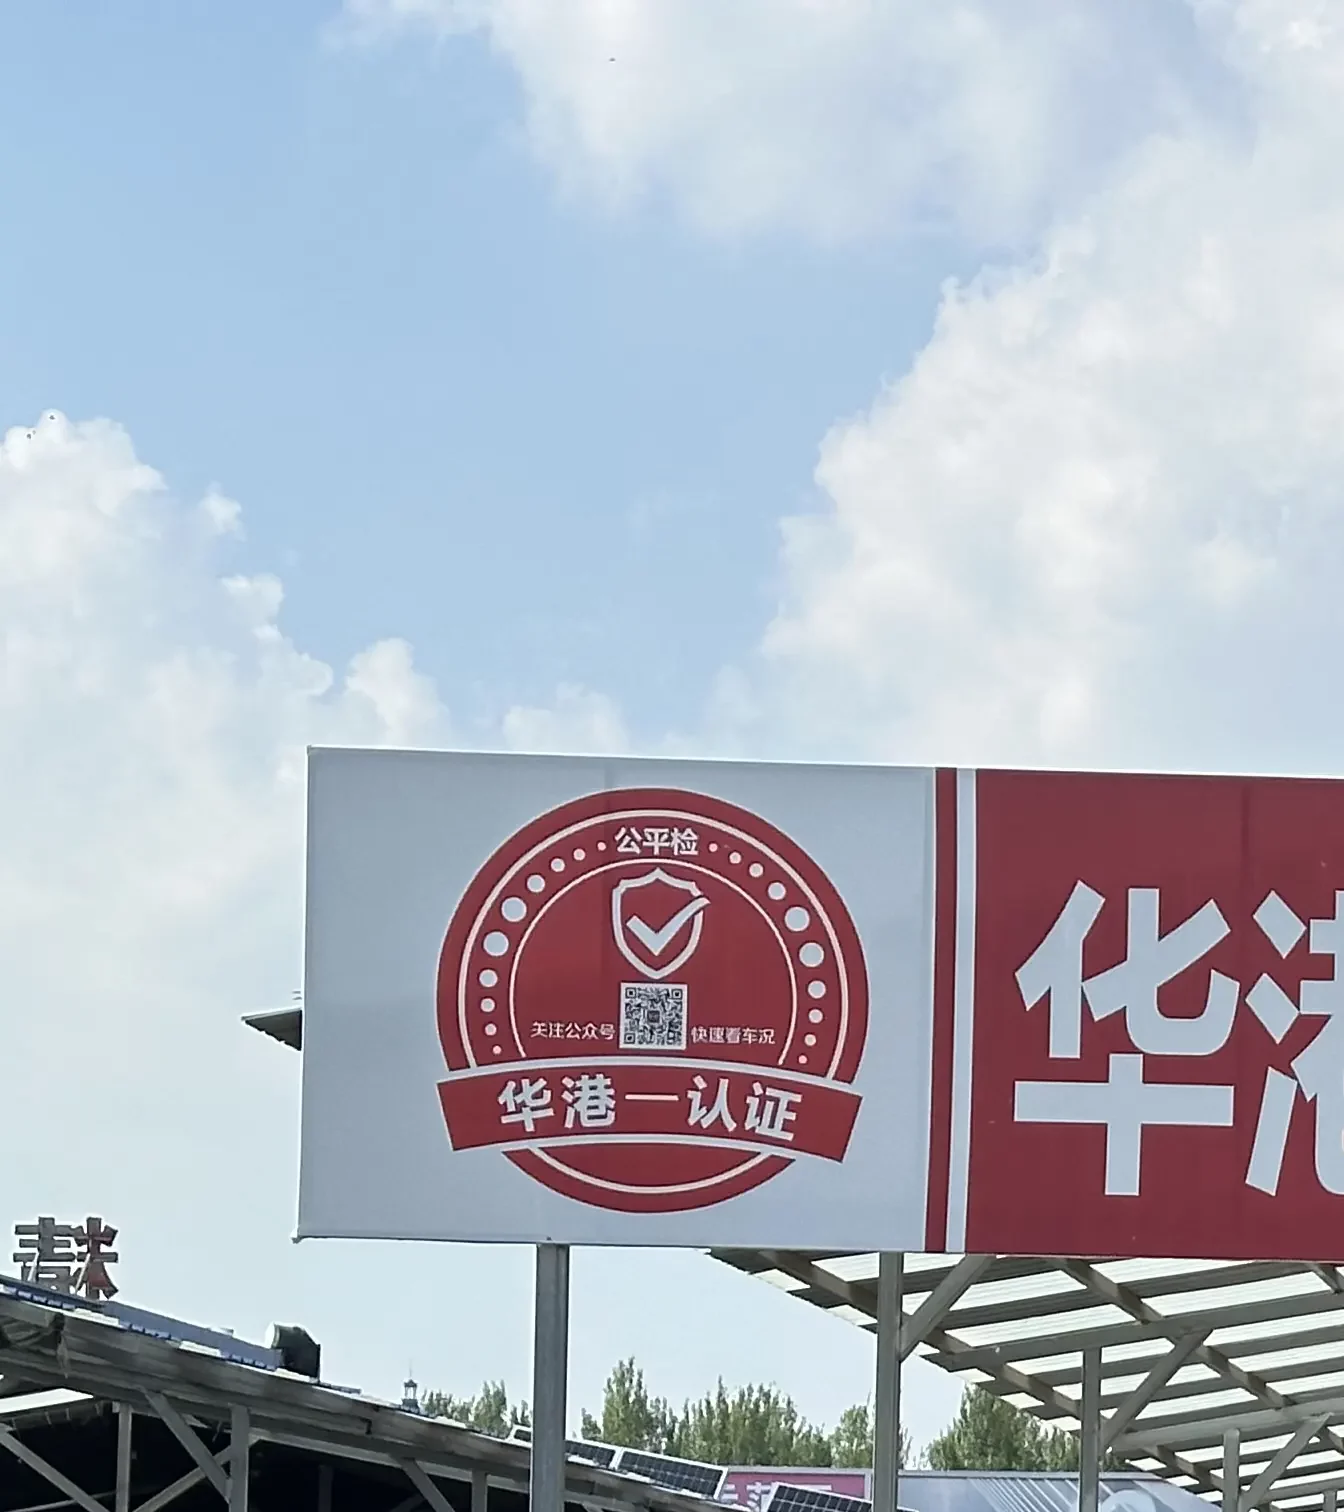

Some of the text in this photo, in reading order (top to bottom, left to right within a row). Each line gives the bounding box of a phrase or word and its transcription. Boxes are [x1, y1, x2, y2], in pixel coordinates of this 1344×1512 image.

[614, 826, 700, 857] 公平检
[531, 1021, 616, 1040] 关注公众号
[691, 1026, 776, 1044] 快速看车况
